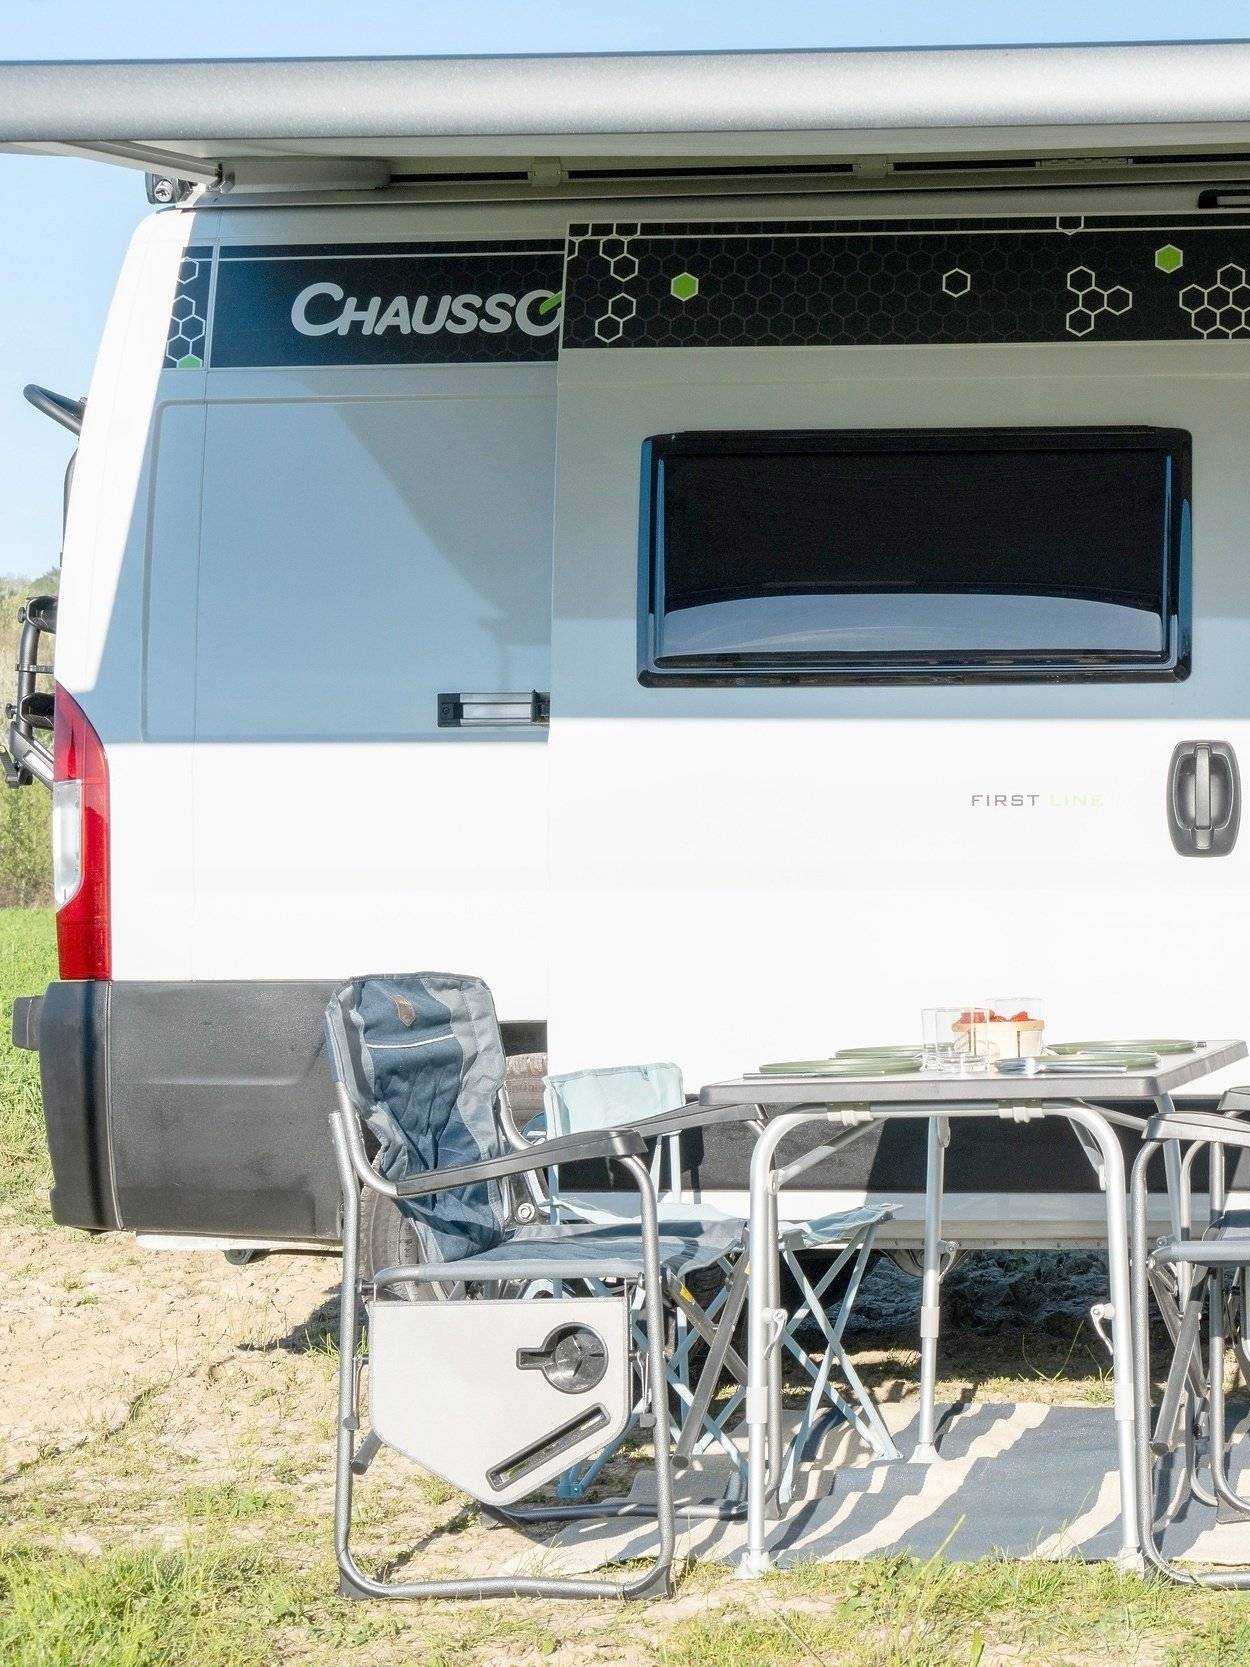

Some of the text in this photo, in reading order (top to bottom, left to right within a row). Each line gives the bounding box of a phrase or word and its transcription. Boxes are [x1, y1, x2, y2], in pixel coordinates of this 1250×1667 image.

[290, 281, 564, 337] CHAUSSO
[971, 794, 1105, 807] FIRST LINE
